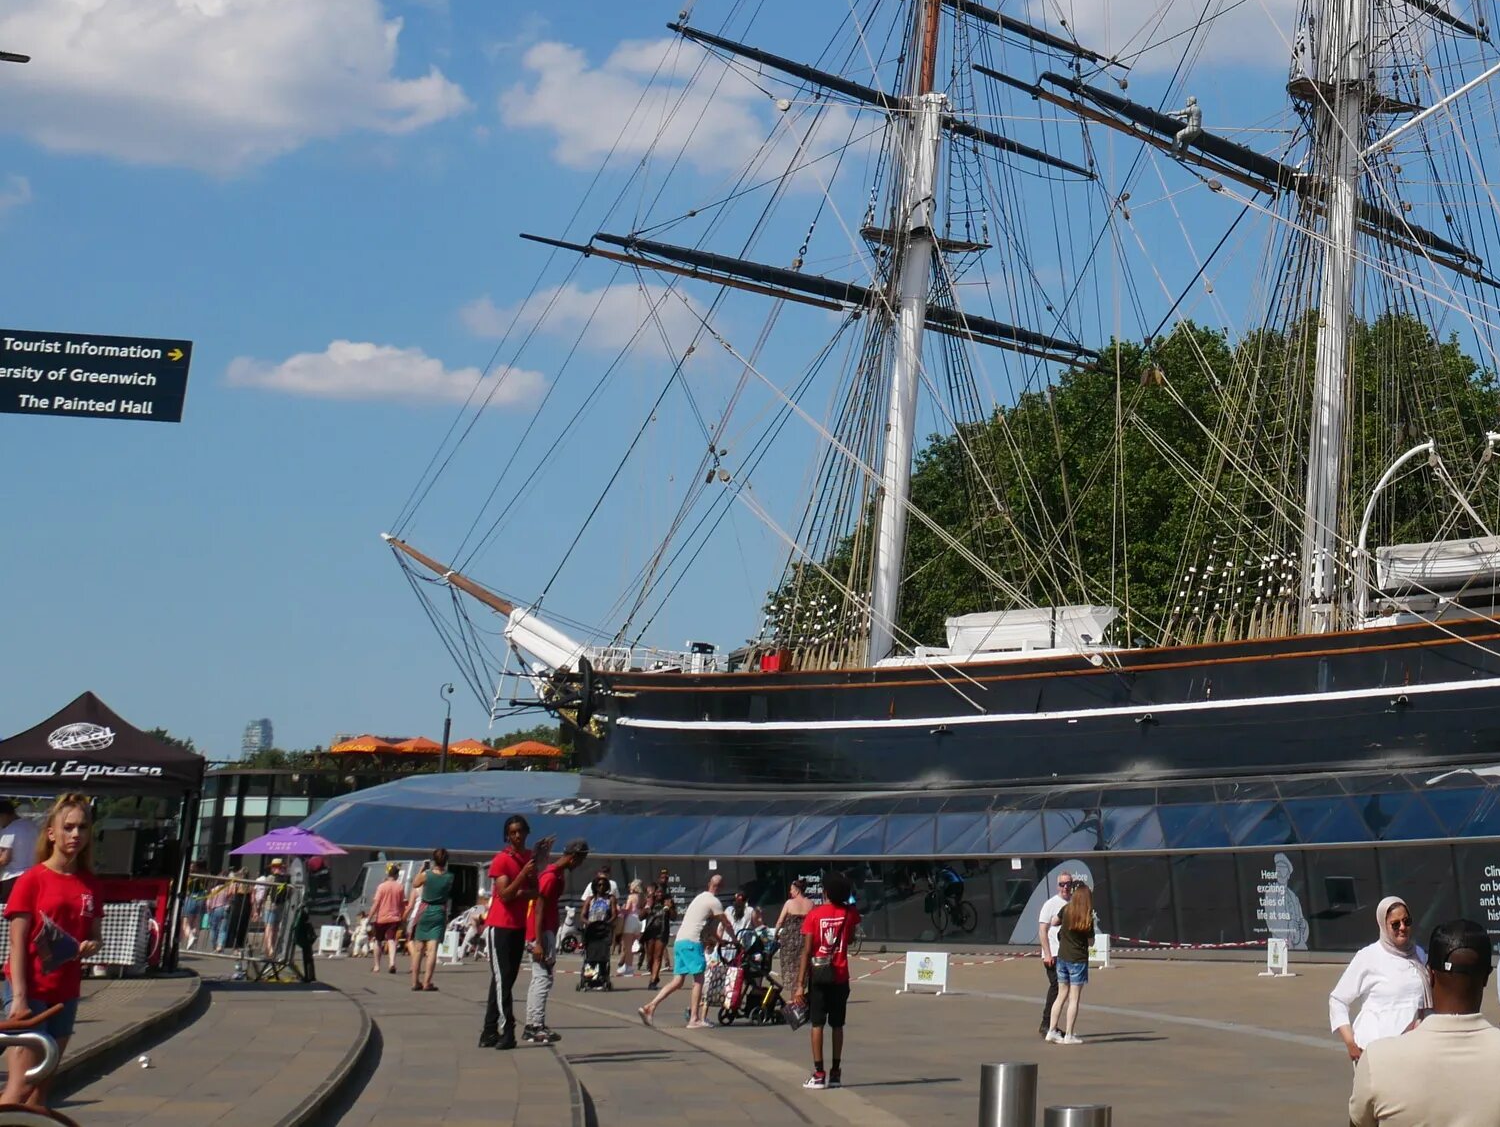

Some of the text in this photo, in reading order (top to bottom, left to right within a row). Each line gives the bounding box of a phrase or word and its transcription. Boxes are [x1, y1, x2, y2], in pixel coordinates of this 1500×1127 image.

[4, 337, 162, 359] Tourist Information
[47, 368, 67, 381] of
[70, 368, 157, 386] Greenwich
[19, 394, 153, 414] The Painted Hall
[0, 760, 163, 781] Ideal Espresso
[1260, 869, 1279, 880] Hear
[1256, 883, 1286, 895] exciting
[1480, 882, 1491, 892] on
[1259, 896, 1285, 907] tales of
[1479, 894, 1496, 906] and
[1256, 909, 1291, 920] life at sea
